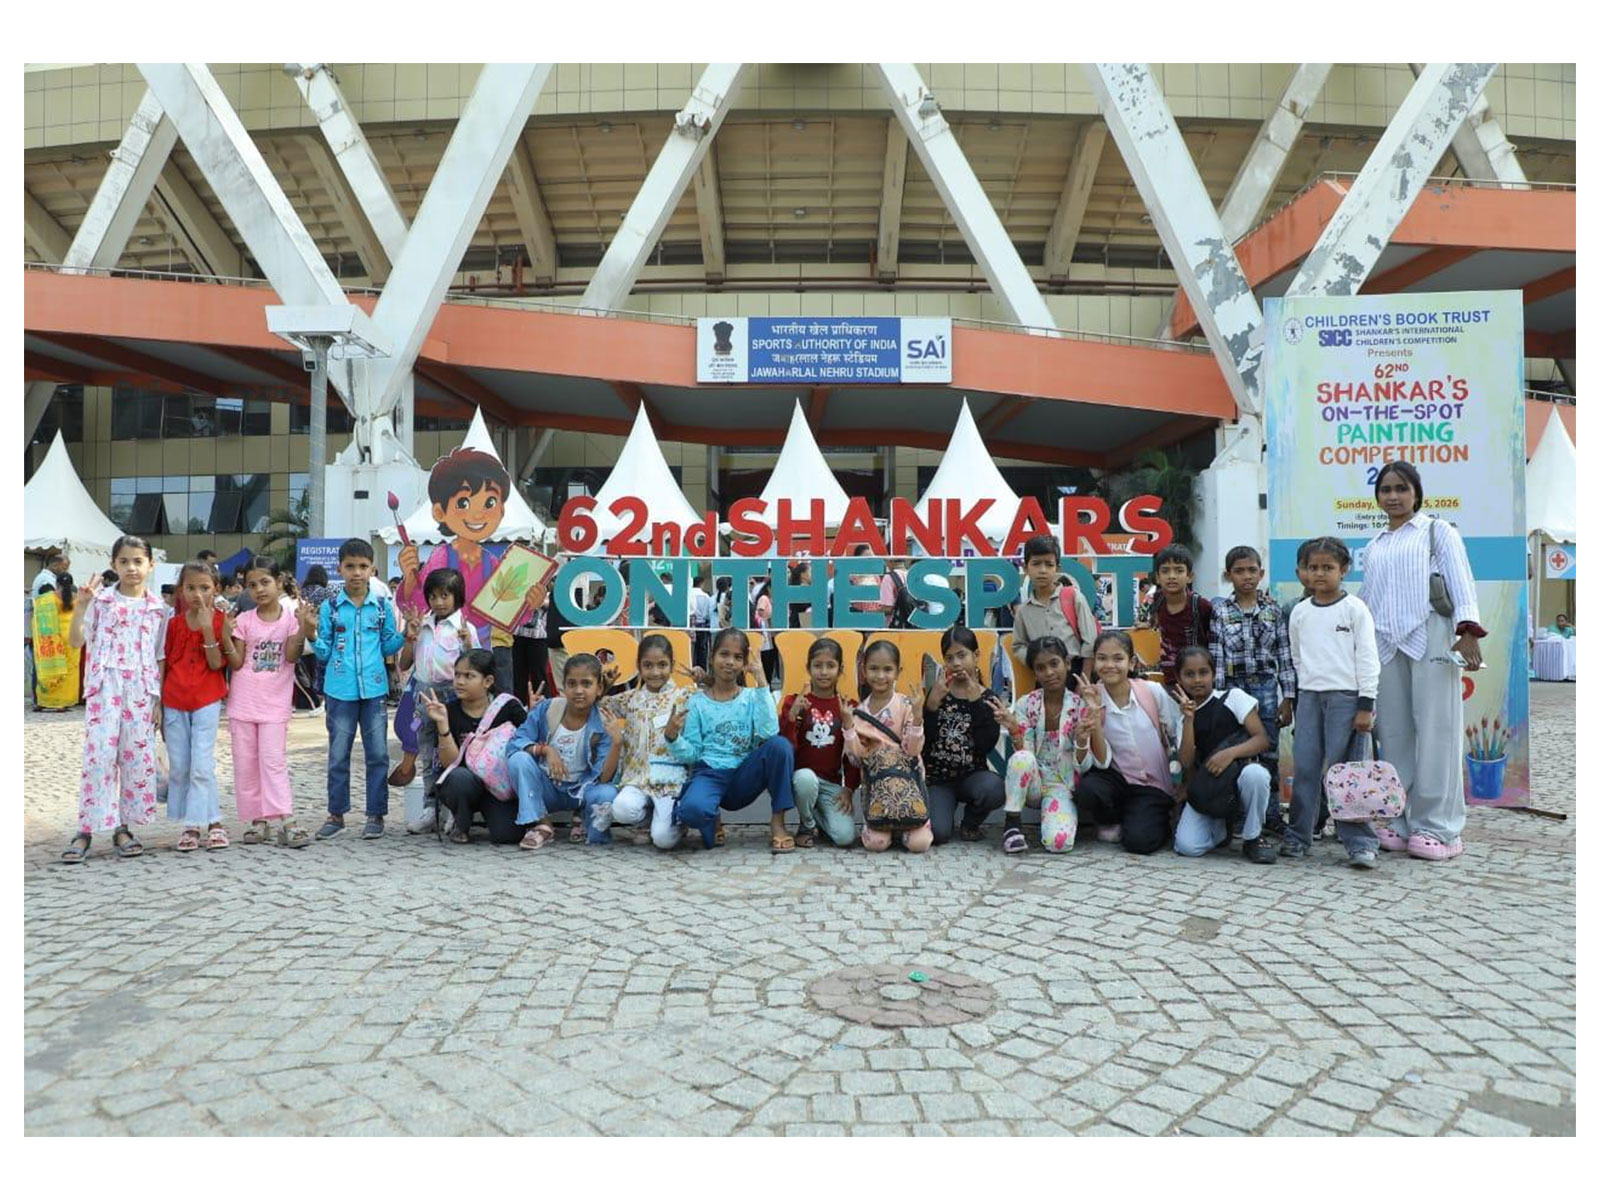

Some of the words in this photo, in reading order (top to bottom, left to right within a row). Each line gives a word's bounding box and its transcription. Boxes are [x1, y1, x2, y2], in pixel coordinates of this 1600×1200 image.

[771, 321, 807, 335] भारतीय
[808, 321, 829, 335] खेल
[831, 321, 878, 335] प्राधिकरण
[1304, 314, 1392, 329] CHILDREN'S
[1396, 312, 1438, 326] BOOK
[1442, 310, 1491, 324] TRUST
[1318, 329, 1352, 347] SICC
[1355, 328, 1400, 336] SHANKAR'S
[1401, 326, 1464, 335] INTERNATIONAL
[752, 338, 793, 350] SPORTS
[854, 338, 869, 350] OF
[870, 338, 898, 350] INDIA
[906, 337, 946, 359] SAI
[1355, 338, 1401, 346] CHILDREN'S
[1402, 336, 1458, 345] COMPETITION
[1367, 348, 1413, 358] Presents
[820, 366, 854, 378] NEHRU
[856, 366, 899, 378] STADIUM
[1374, 363, 1410, 379] 62ND
[1316, 374, 1470, 404] SHANKAR'S
[1322, 403, 1464, 423] ON-THE-SPOT
[1337, 421, 1454, 445] PAINTING
[1319, 444, 1469, 466] COMPETITION
[1336, 499, 1375, 510] Sunday,
[1435, 498, 1460, 508] 2026
[557, 495, 721, 558] 62nd
[727, 494, 1174, 558] SHANKARS
[301, 546, 339, 555] REGISTRAT
[553, 556, 691, 627] ON
[712, 557, 886, 629] THE
